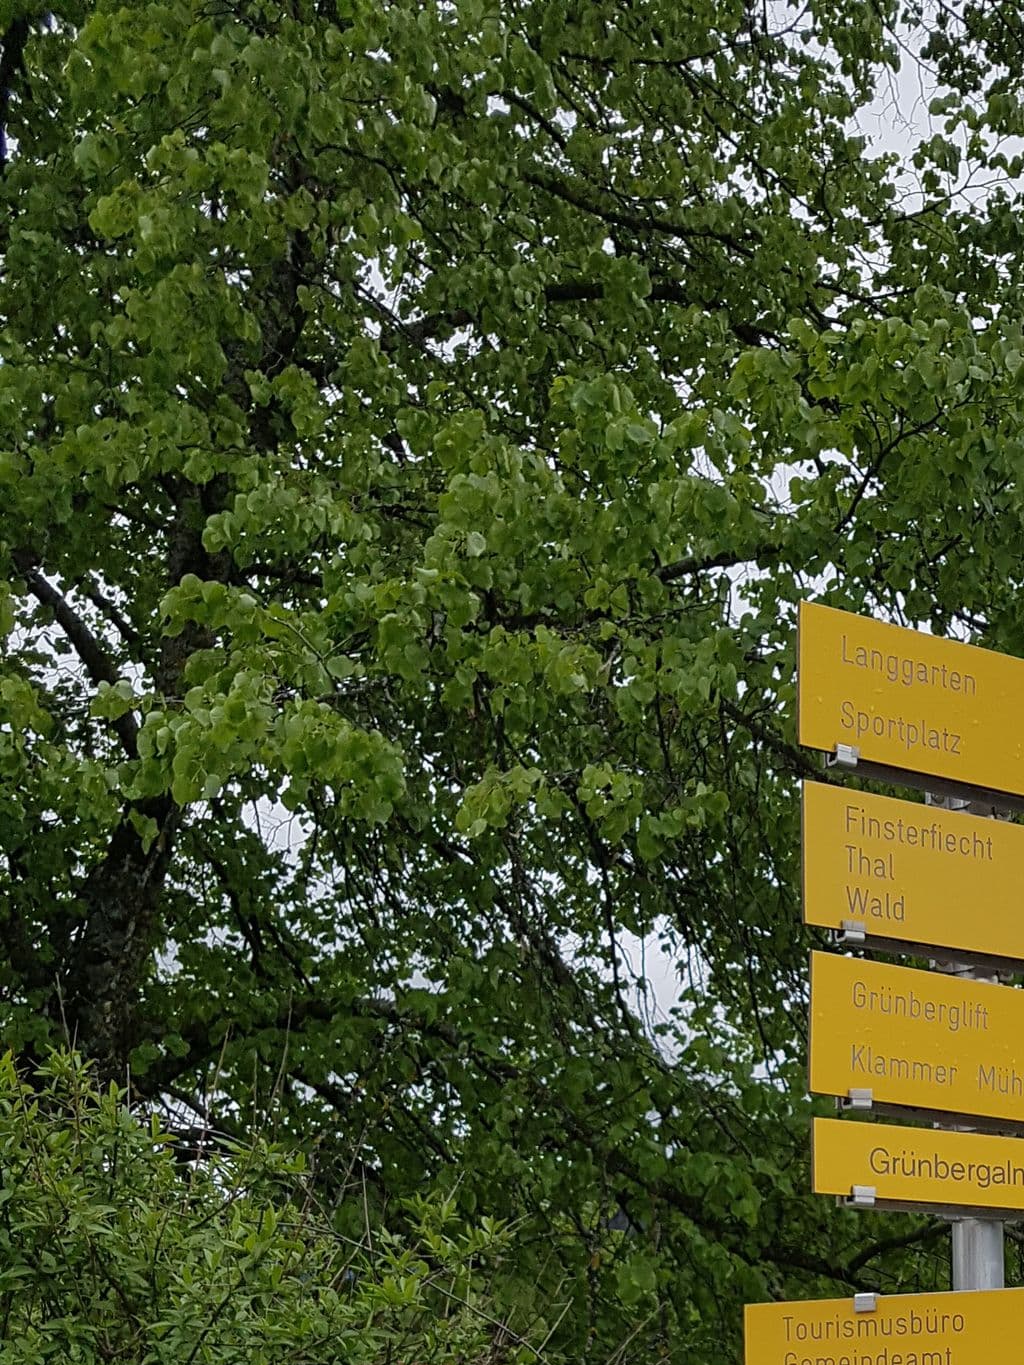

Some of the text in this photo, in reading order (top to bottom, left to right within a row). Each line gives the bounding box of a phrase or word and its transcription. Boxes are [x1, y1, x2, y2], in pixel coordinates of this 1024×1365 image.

[840, 635, 977, 696] Langgarten
[840, 701, 962, 756] Sportplatz
[845, 805, 993, 861] Finsterfiecht
[845, 845, 895, 881] Thal
[846, 886, 905, 922] Wald
[852, 982, 989, 1031] Grünberglift
[850, 1044, 958, 1087] Klammer
[783, 1309, 965, 1342] Tourismusbüro
